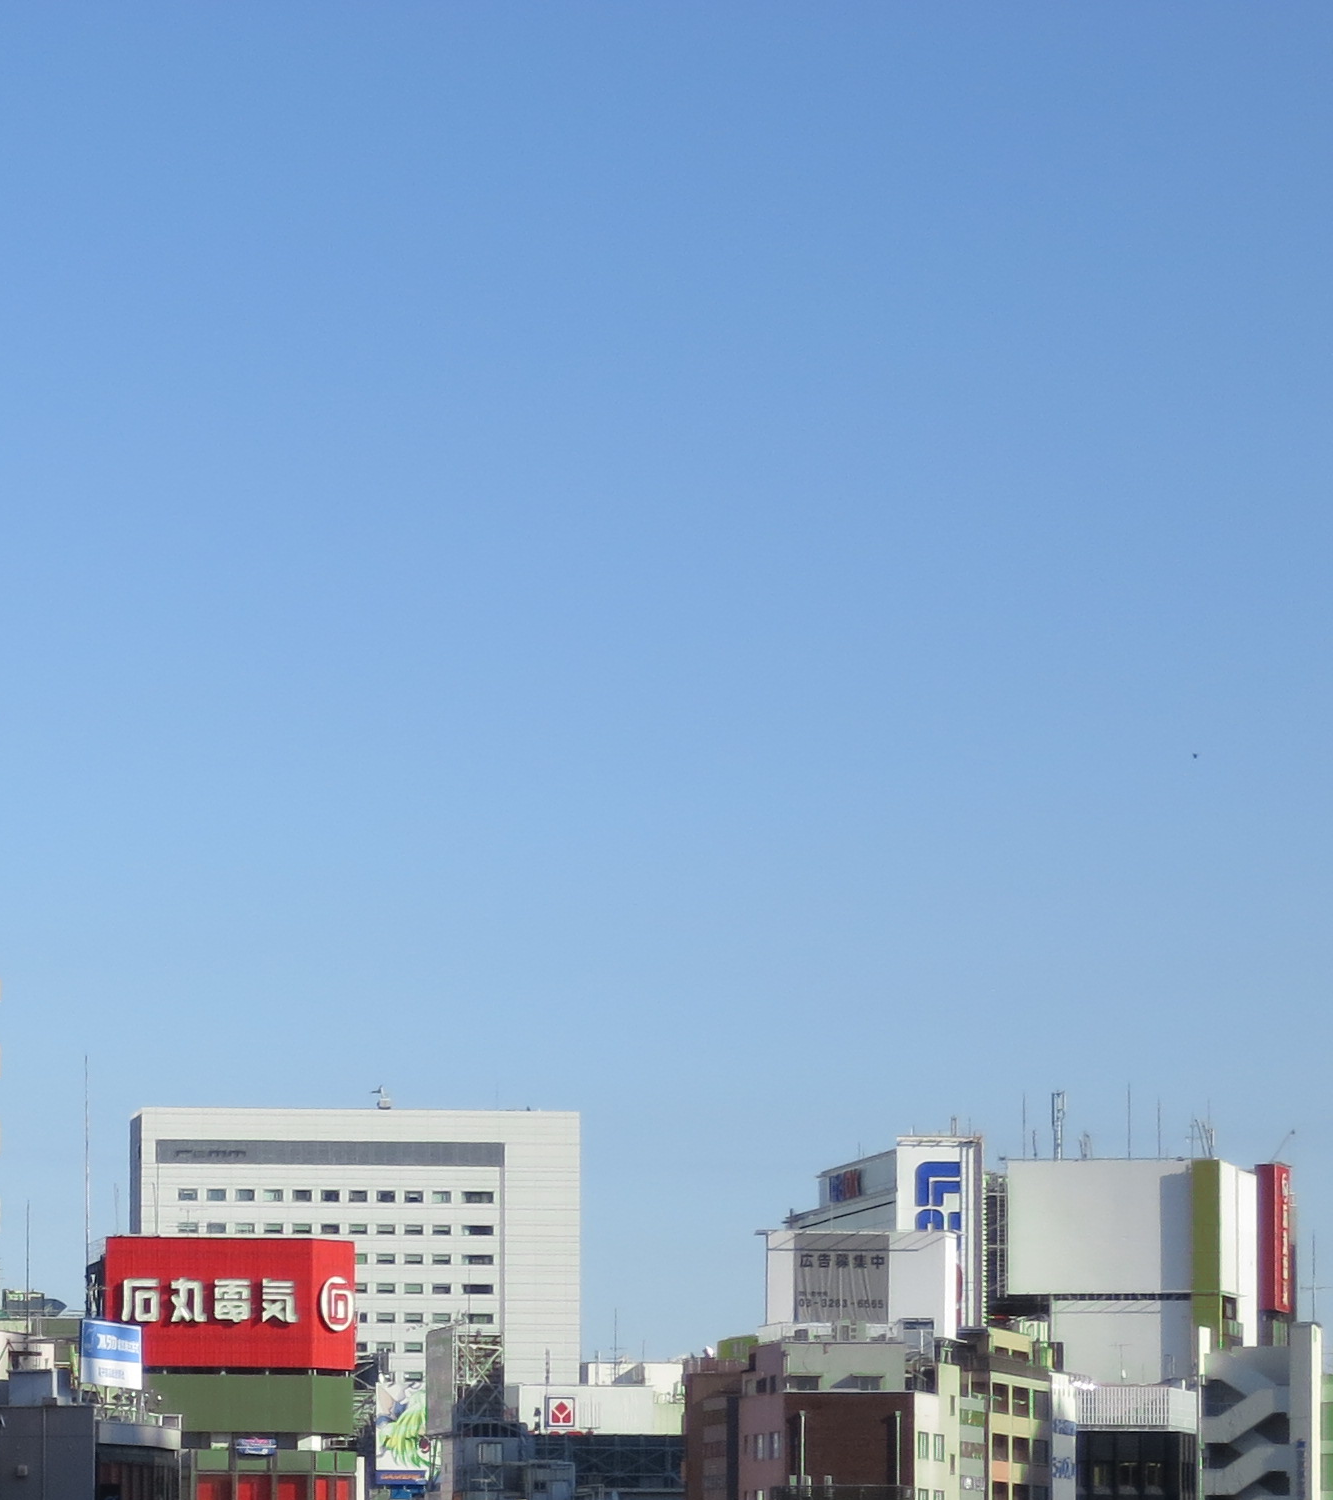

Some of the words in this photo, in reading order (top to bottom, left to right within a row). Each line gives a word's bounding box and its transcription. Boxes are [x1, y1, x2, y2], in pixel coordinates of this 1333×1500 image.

[800, 1253, 885, 1270] 広告募集中
[121, 1278, 300, 1323] 石丸電気
